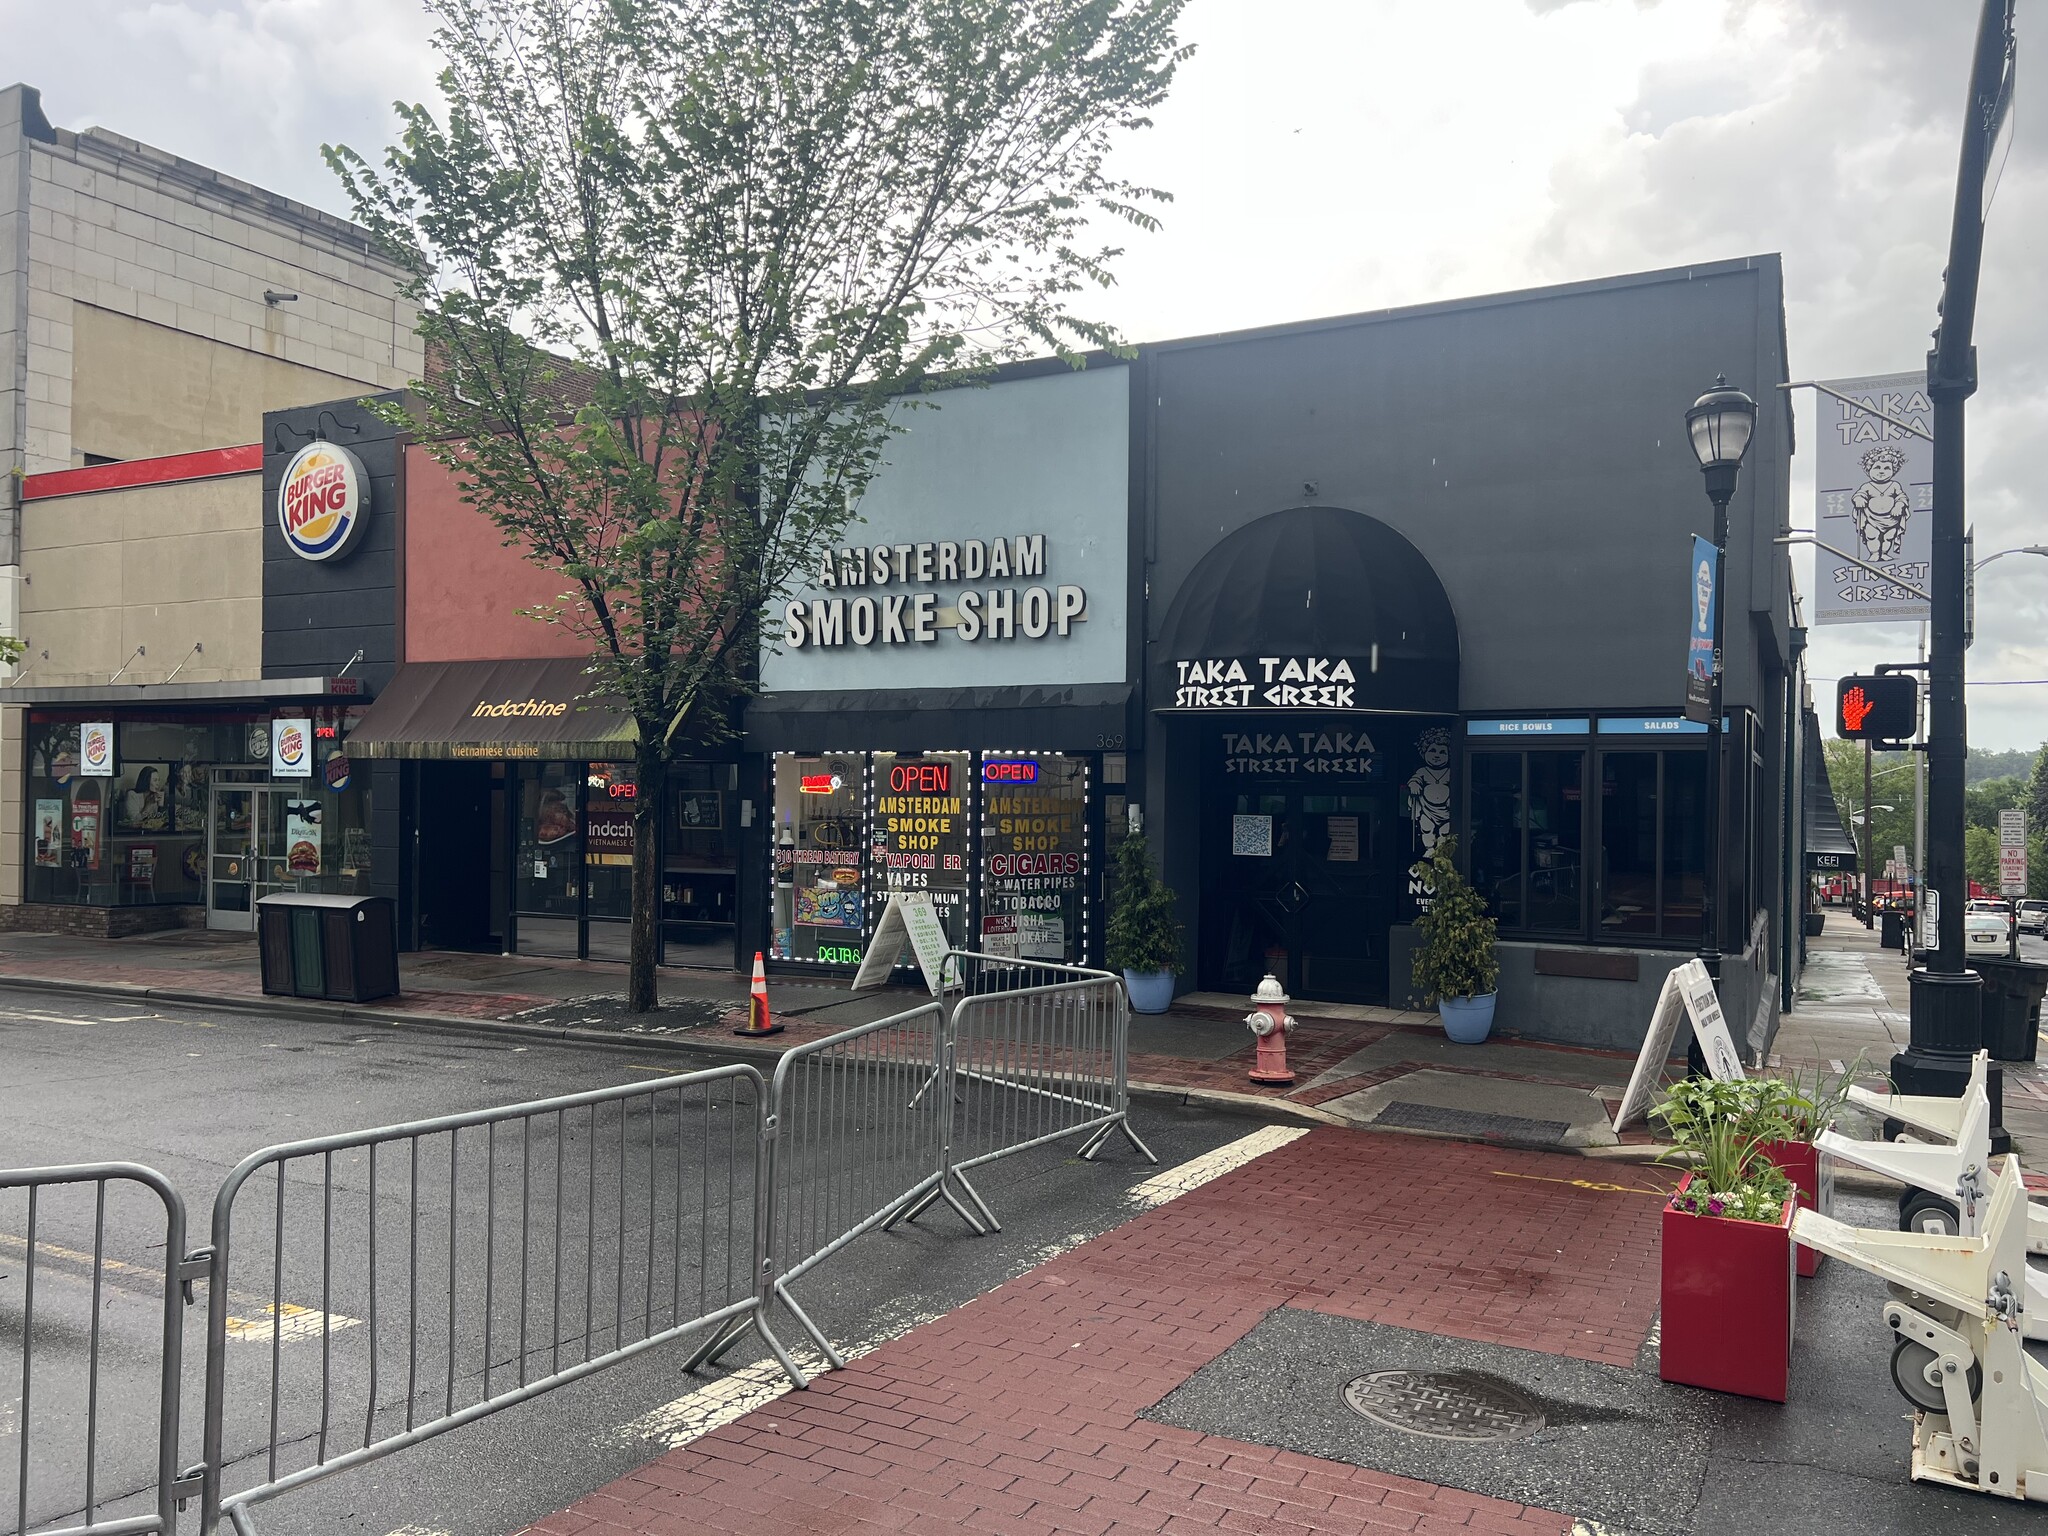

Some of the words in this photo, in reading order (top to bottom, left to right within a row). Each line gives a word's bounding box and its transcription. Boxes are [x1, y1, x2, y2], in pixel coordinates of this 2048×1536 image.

[1837, 391, 1930, 420] TAKA
[1837, 416, 1931, 445] TAKA
[287, 463, 345, 506] BURGER
[289, 482, 346, 533] KING
[818, 534, 1047, 587] AMSTERDAM
[1833, 562, 1929, 583] STREET
[1838, 583, 1924, 602] GREEK
[784, 592, 938, 648] SMOKE
[957, 584, 1087, 641] SHOP
[1176, 659, 1247, 685] TAKA
[1259, 657, 1356, 683] TAKA
[331, 685, 357, 694] KING
[1175, 685, 1255, 707] STREET
[1263, 684, 1355, 707] GREEK
[471, 699, 567, 718] indochine
[316, 728, 335, 738] OPEN
[1499, 723, 1519, 732] RICE
[1522, 723, 1552, 731] BOWLS
[1644, 721, 1679, 730] SALADS
[281, 732, 301, 748] BURGER
[1096, 734, 1124, 749] 369
[1222, 733, 1293, 754] TAKA
[1298, 732, 1375, 754] TAKA
[88, 742, 106, 757] KING
[281, 740, 302, 757] KING
[452, 745, 503, 757] vietnamese
[506, 745, 539, 757] cuisine
[985, 764, 1034, 780] OPEN
[1224, 758, 1299, 773] STREET
[1302, 758, 1373, 773] GREEK
[327, 764, 350, 784] KING
[891, 766, 948, 791] OPEN
[879, 797, 961, 814] AMSTERDAM
[588, 821, 634, 837] indoch
[887, 819, 951, 833] SMOKE
[1000, 818, 1072, 834] SMOKE
[589, 838, 627, 847] VIETNAMESE
[898, 835, 939, 850] SHOP
[1012, 835, 1059, 851] SHOP
[776, 849, 792, 862] 510
[792, 849, 823, 863] THREAD
[824, 850, 860, 864] BATTERY
[990, 853, 1080, 876] CIGARS
[1817, 856, 1839, 865] KEFI
[2001, 858, 2024, 866] PARKING
[887, 872, 928, 887] VAPES
[1004, 878, 1040, 891] WATER
[1044, 876, 1075, 889] PIPES
[1003, 895, 1060, 911] TOBACCO
[913, 906, 927, 918] 369
[1004, 915, 1044, 928] SHISHA
[916, 930, 937, 938] EDIBLES
[1004, 931, 1049, 946] HOOKAH
[818, 946, 851, 963] DELTA
